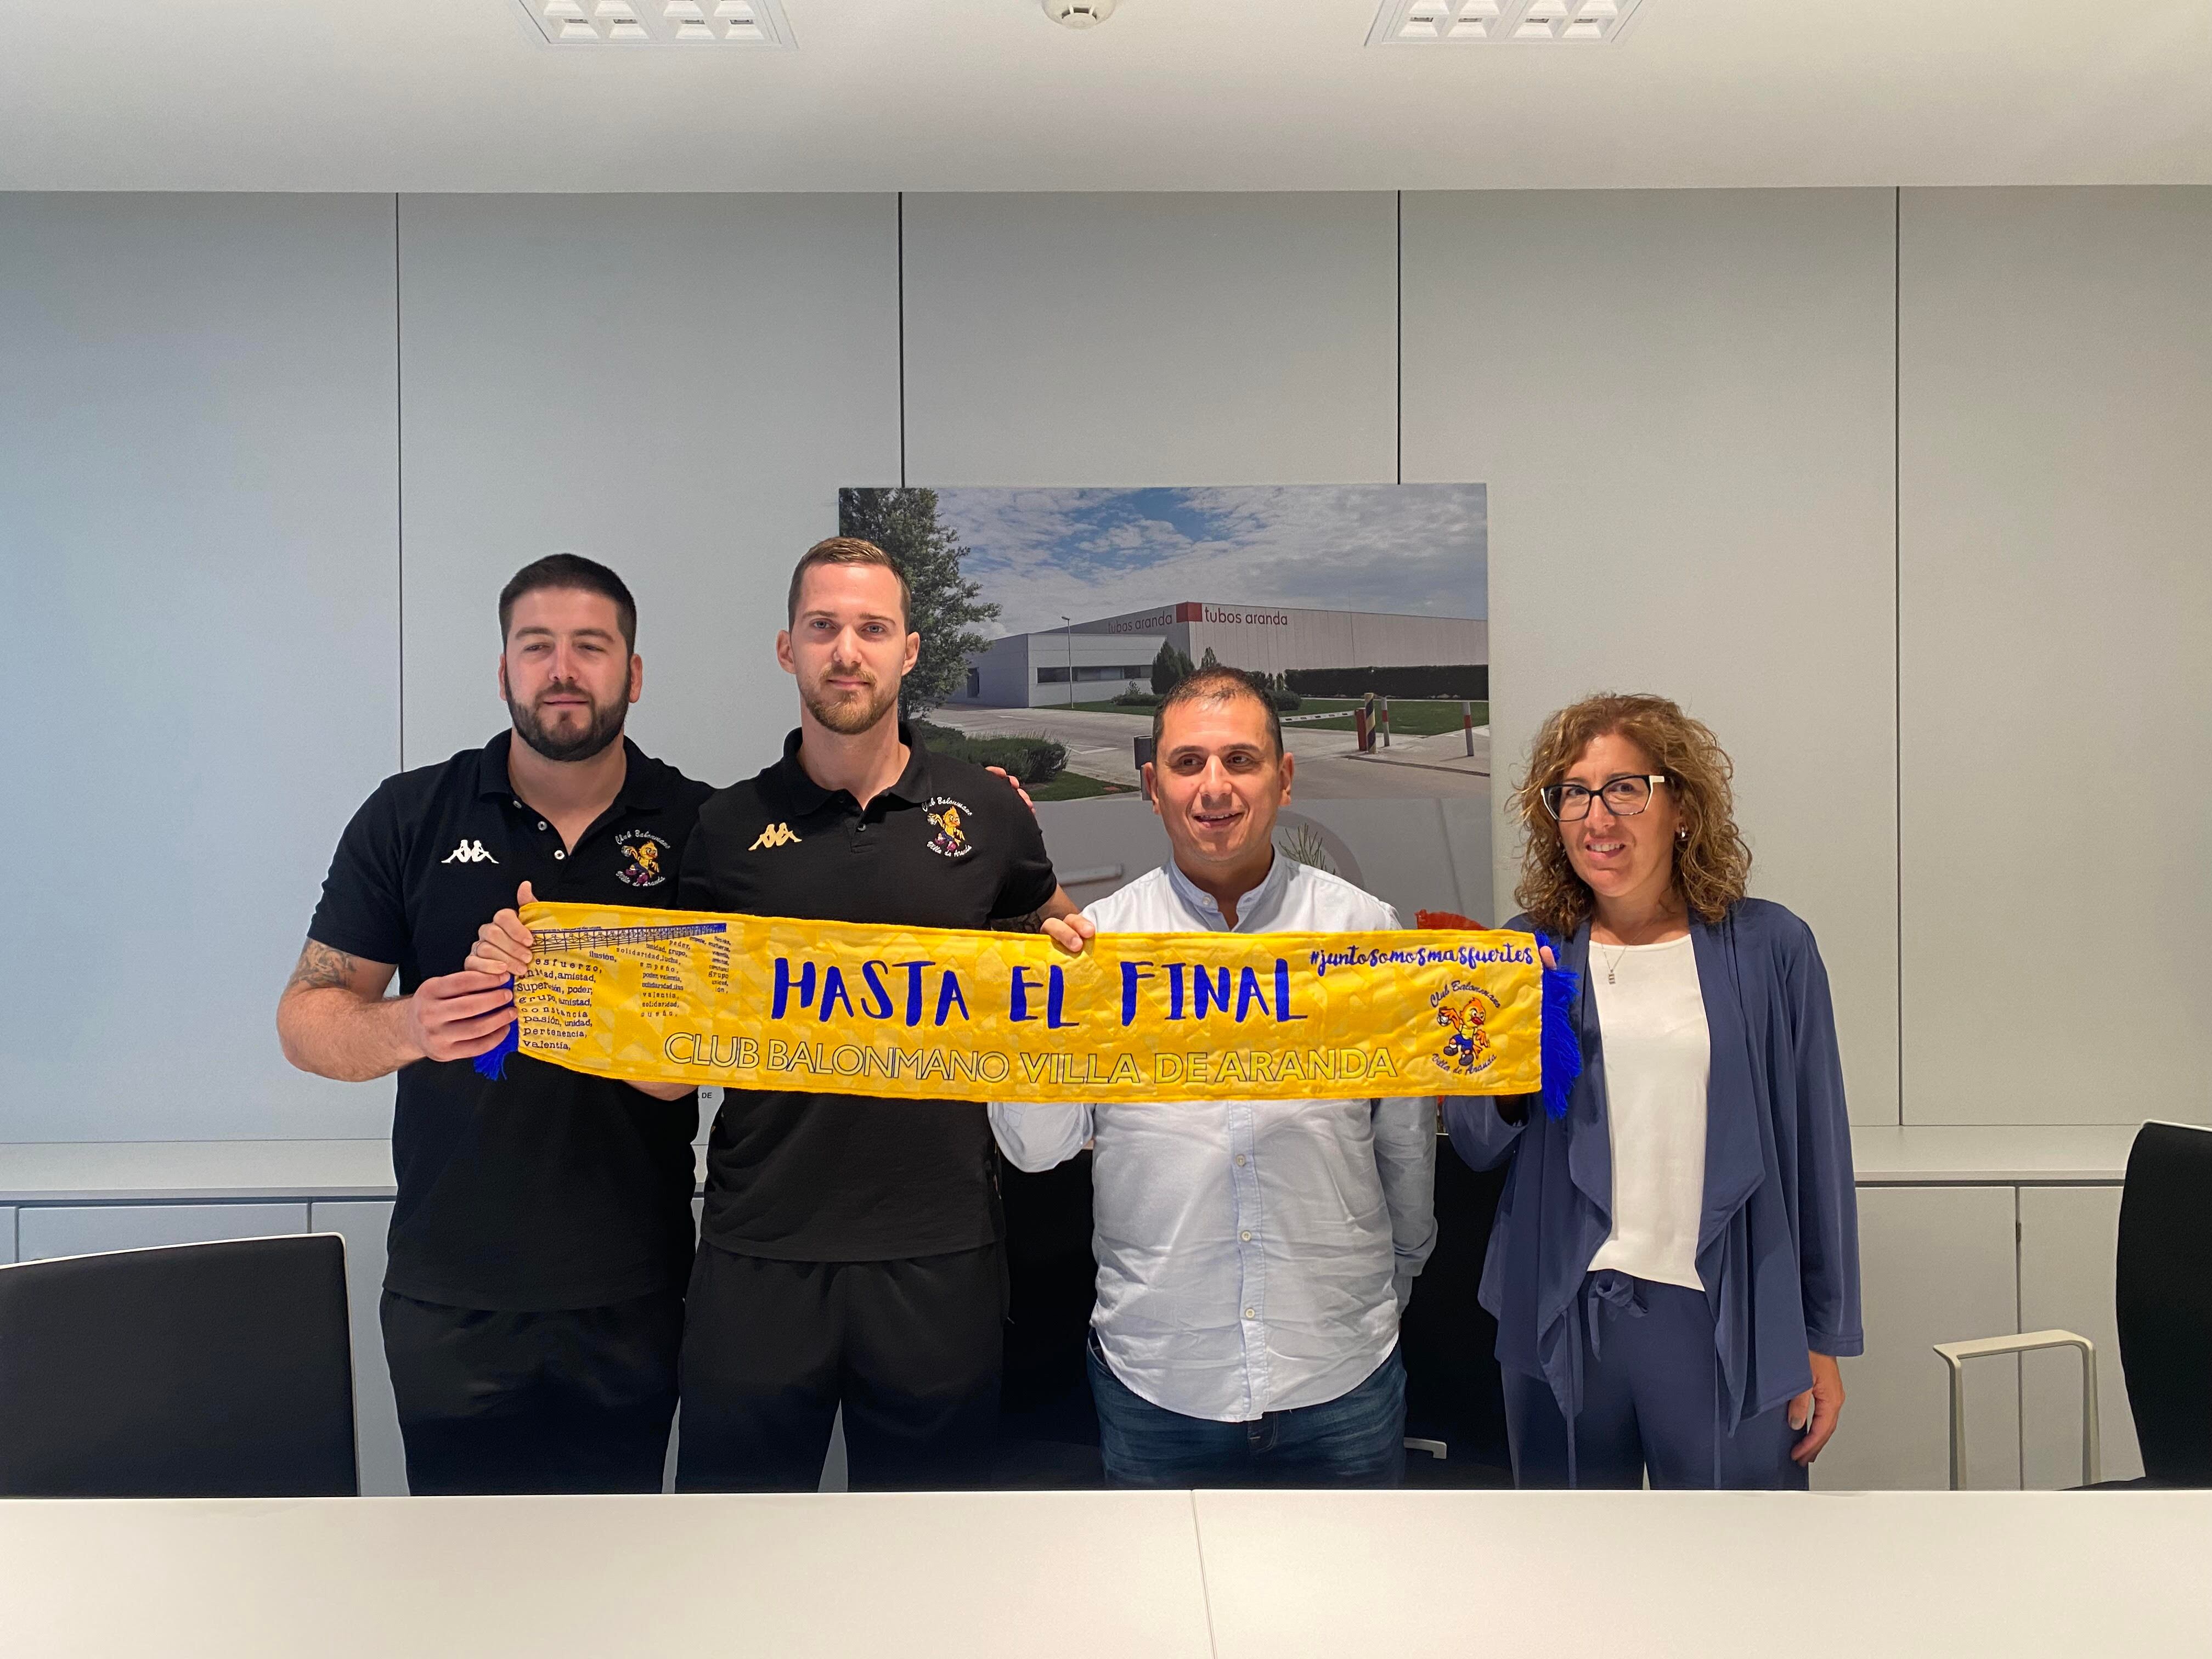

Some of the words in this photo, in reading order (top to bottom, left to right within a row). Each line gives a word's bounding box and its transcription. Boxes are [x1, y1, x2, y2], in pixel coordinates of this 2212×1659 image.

[1108, 619, 1132, 633] tubos
[1135, 611, 1172, 629] aranda
[1205, 607, 1242, 624] tubos
[1245, 611, 1288, 626] aranda
[922, 797, 935, 812] Club
[615, 831, 632, 845] Club
[589, 951, 617, 963] ilusión,
[536, 958, 602, 973] esfuerzo,
[771, 957, 969, 1026] HASTA
[1009, 964, 1080, 1029] EL
[1121, 958, 1308, 1026] FINAL
[1430, 984, 1449, 1008] Club
[1451, 980, 1501, 1008] Balonmano
[558, 998, 592, 1007] amistad,
[521, 1007, 588, 1018] constancia
[523, 1015, 562, 1027] pasión,
[565, 1019, 593, 1027] unidad,
[523, 1028, 587, 1038] pertenencia,
[522, 1040, 571, 1051] valentía,
[665, 1032, 759, 1068] CLUB
[768, 1039, 1009, 1082] BALONMANO
[1019, 1052, 1141, 1084] VILLA
[1154, 1052, 1207, 1084] DE
[1216, 1047, 1398, 1082] ARANDA
[1432, 1053, 1450, 1070] Villa
[1465, 1054, 1497, 1075] Aranda
